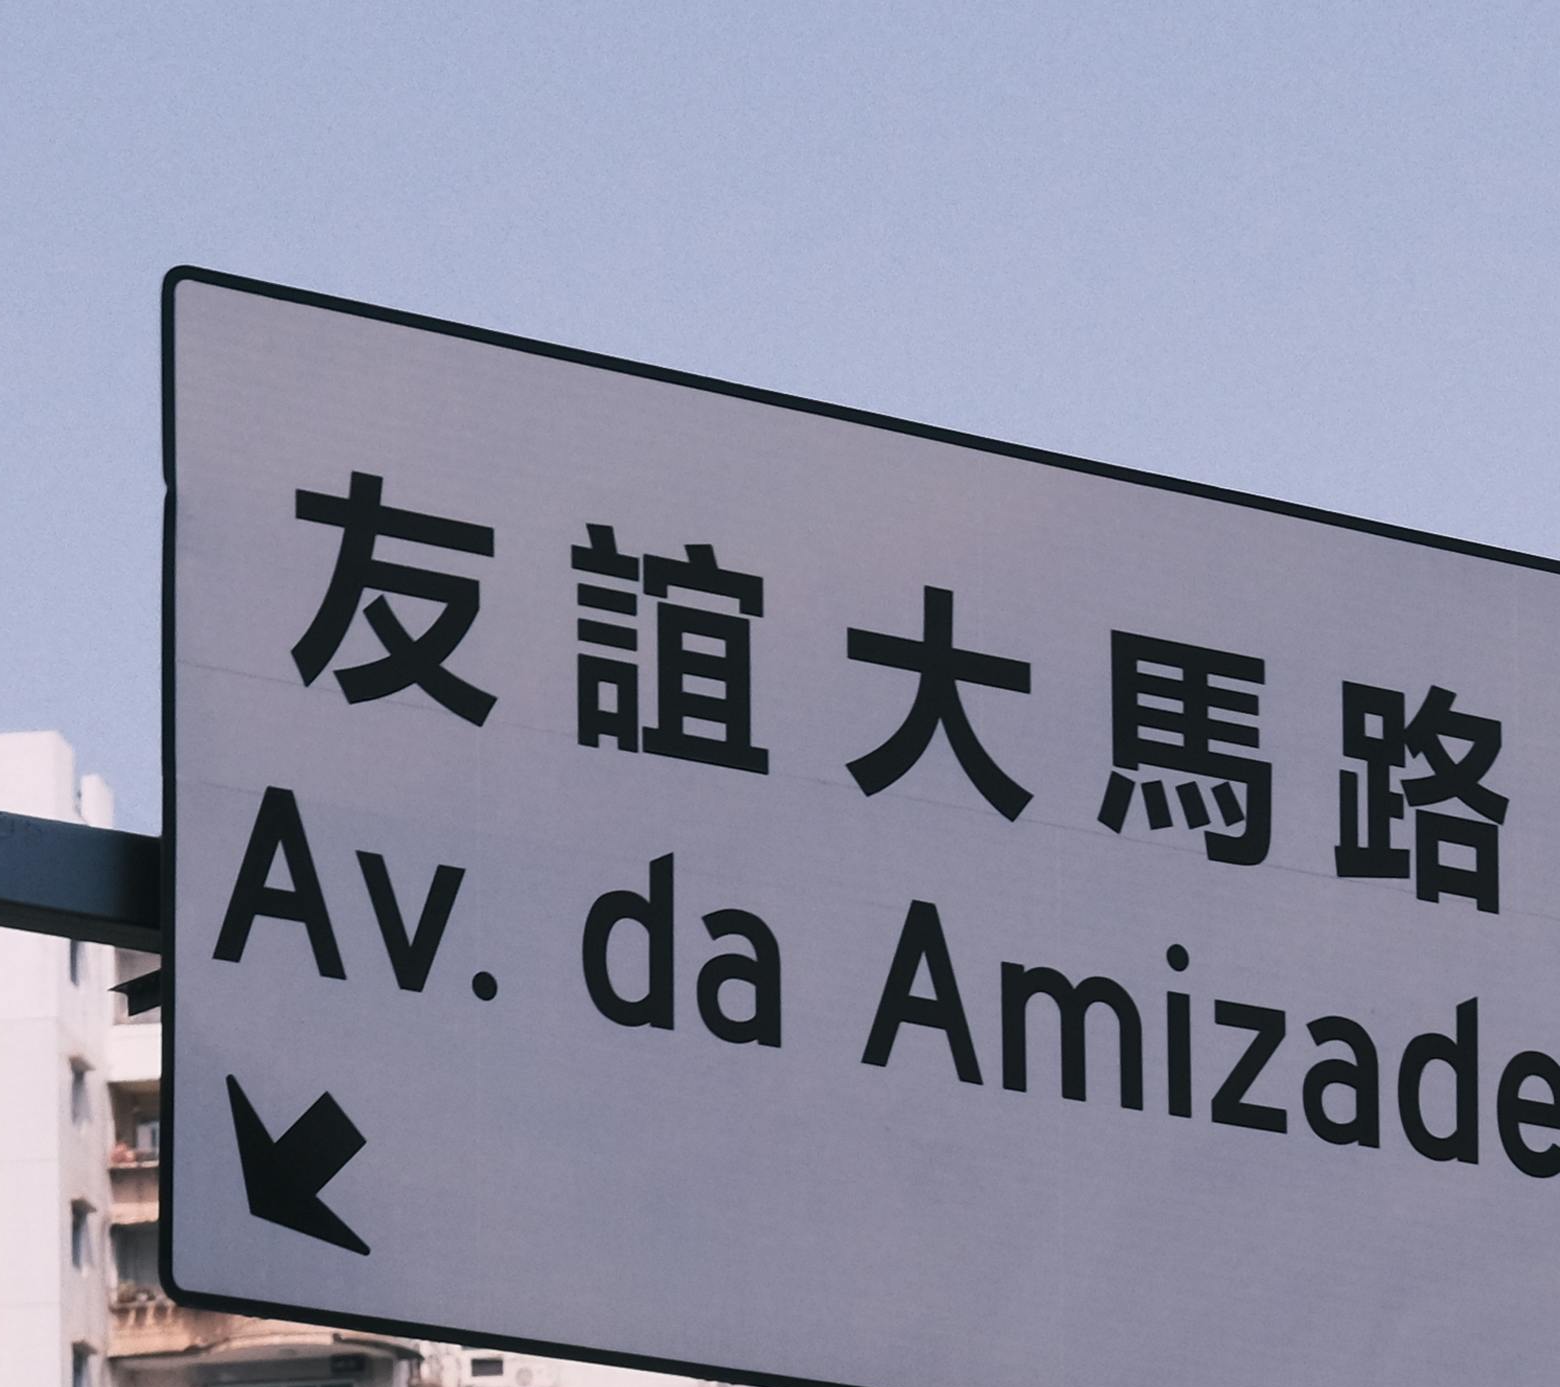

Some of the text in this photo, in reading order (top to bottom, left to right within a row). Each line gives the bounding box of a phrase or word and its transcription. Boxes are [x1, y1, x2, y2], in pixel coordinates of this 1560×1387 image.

[291, 472, 1509, 914] 友誼大馬路
[213, 786, 497, 1001] Av.
[583, 853, 781, 1048] da
